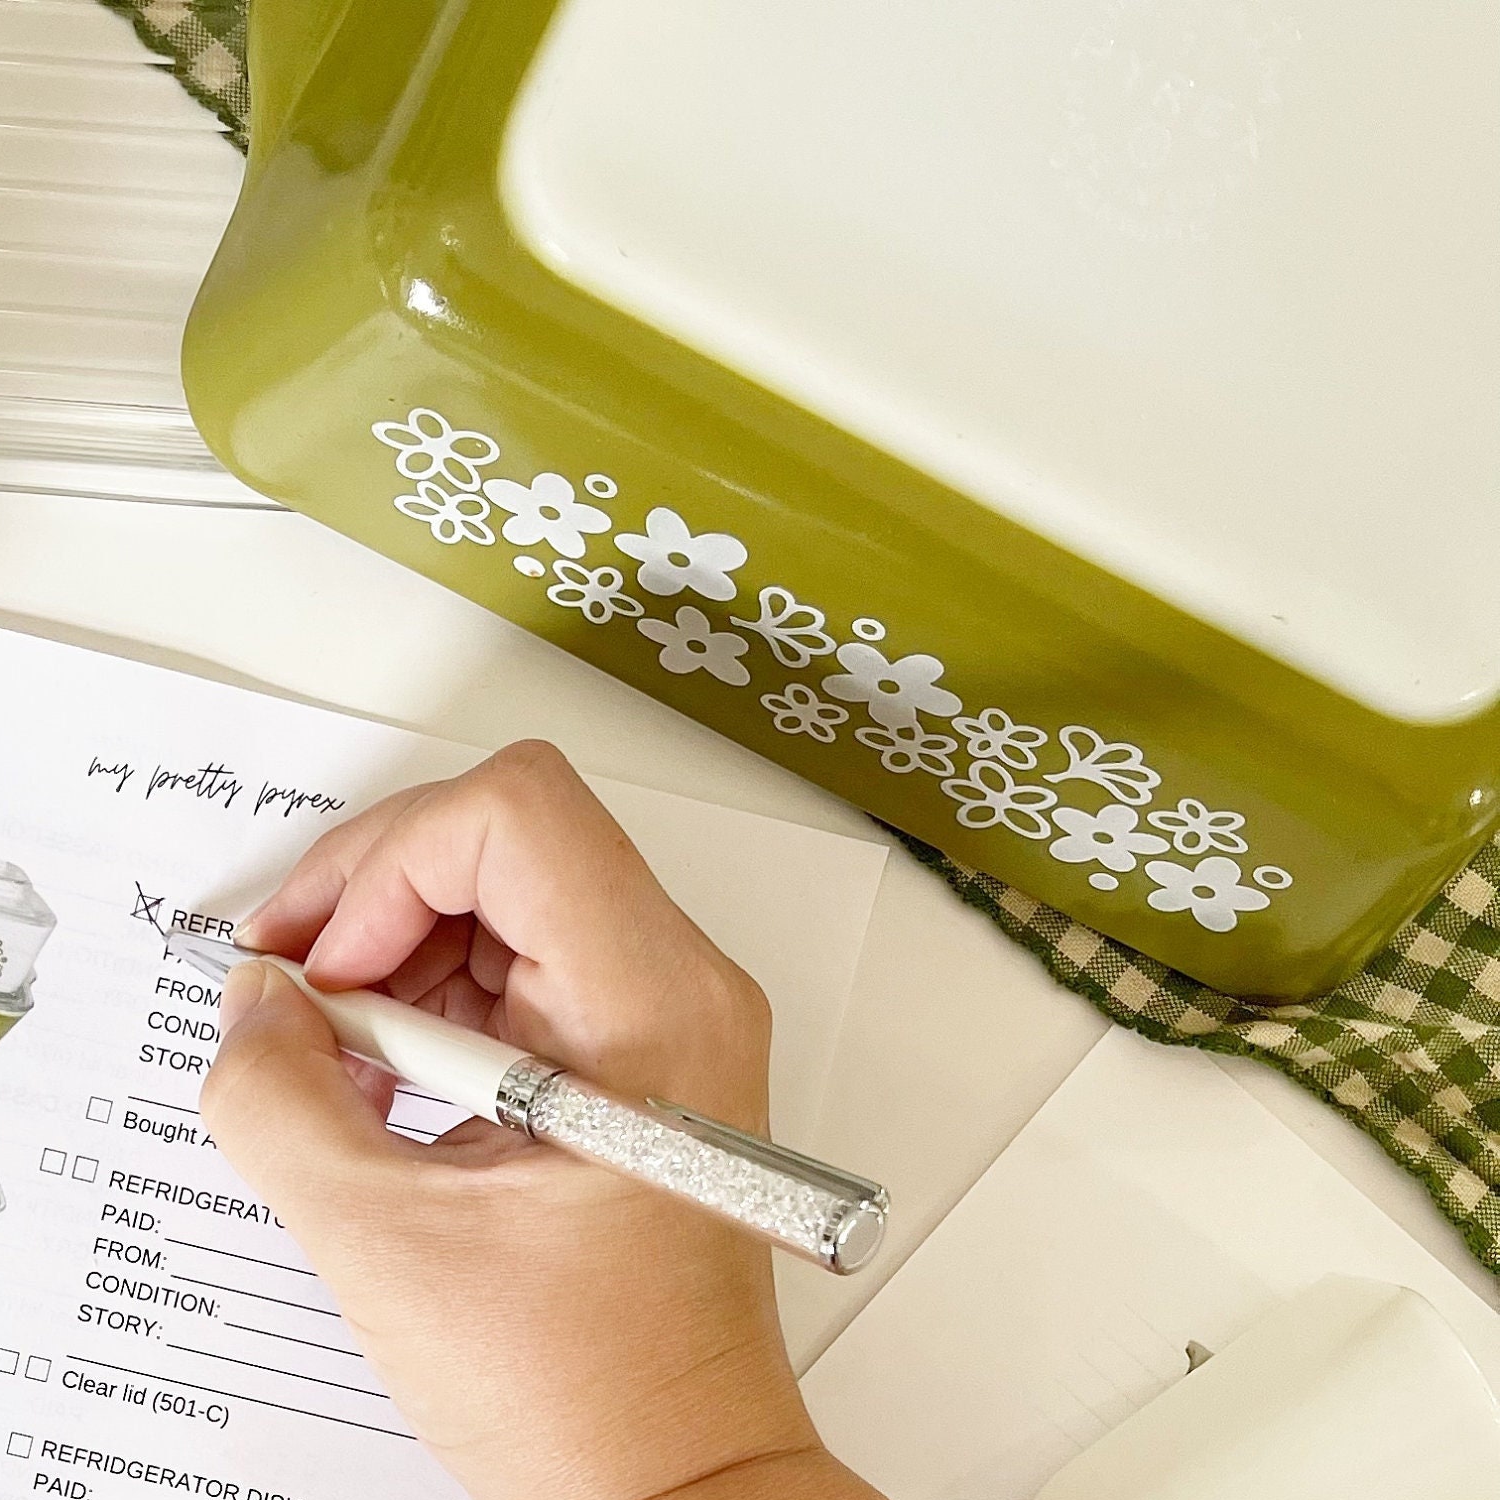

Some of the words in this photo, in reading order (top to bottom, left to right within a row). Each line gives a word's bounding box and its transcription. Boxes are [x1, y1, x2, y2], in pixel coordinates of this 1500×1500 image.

[87, 756, 135, 793] my
[145, 761, 244, 809] pretty
[253, 780, 346, 818] pyrex
[122, 1110, 198, 1145] Bought
[100, 1203, 162, 1234] PAID:
[92, 1236, 168, 1271] FROM:
[85, 1271, 221, 1319] CONDITION:
[77, 1303, 163, 1340] STORY:
[61, 1370, 118, 1399] Clear
[122, 1383, 148, 1406] lid
[152, 1390, 230, 1430] (501-C)
